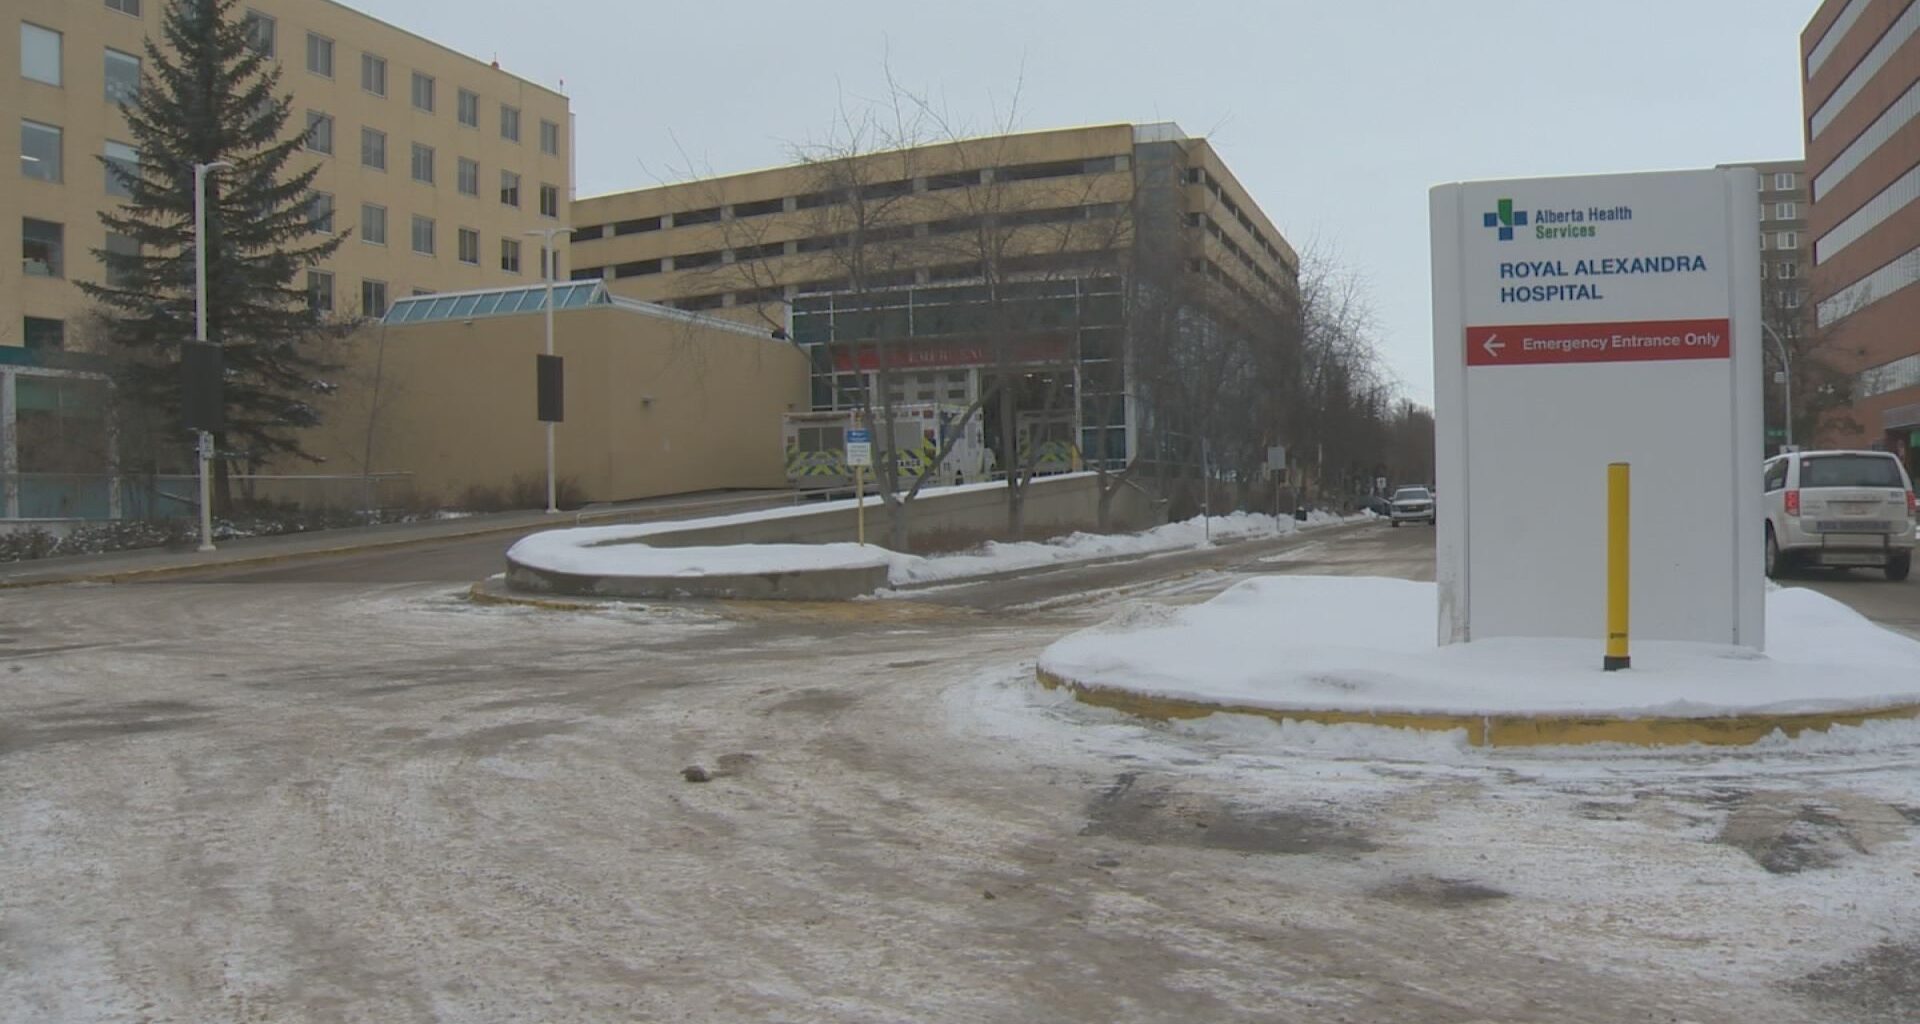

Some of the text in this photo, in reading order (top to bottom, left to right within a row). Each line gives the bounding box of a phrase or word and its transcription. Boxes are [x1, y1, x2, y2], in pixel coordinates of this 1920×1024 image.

[1535, 206, 1633, 224] Alberta Health
[1535, 224, 1596, 239] Services
[1500, 255, 1707, 279] ROYAL ALEXANDRA
[1500, 284, 1603, 303] HOSPITAL
[1523, 331, 1720, 351] Emergency Entrance Only
